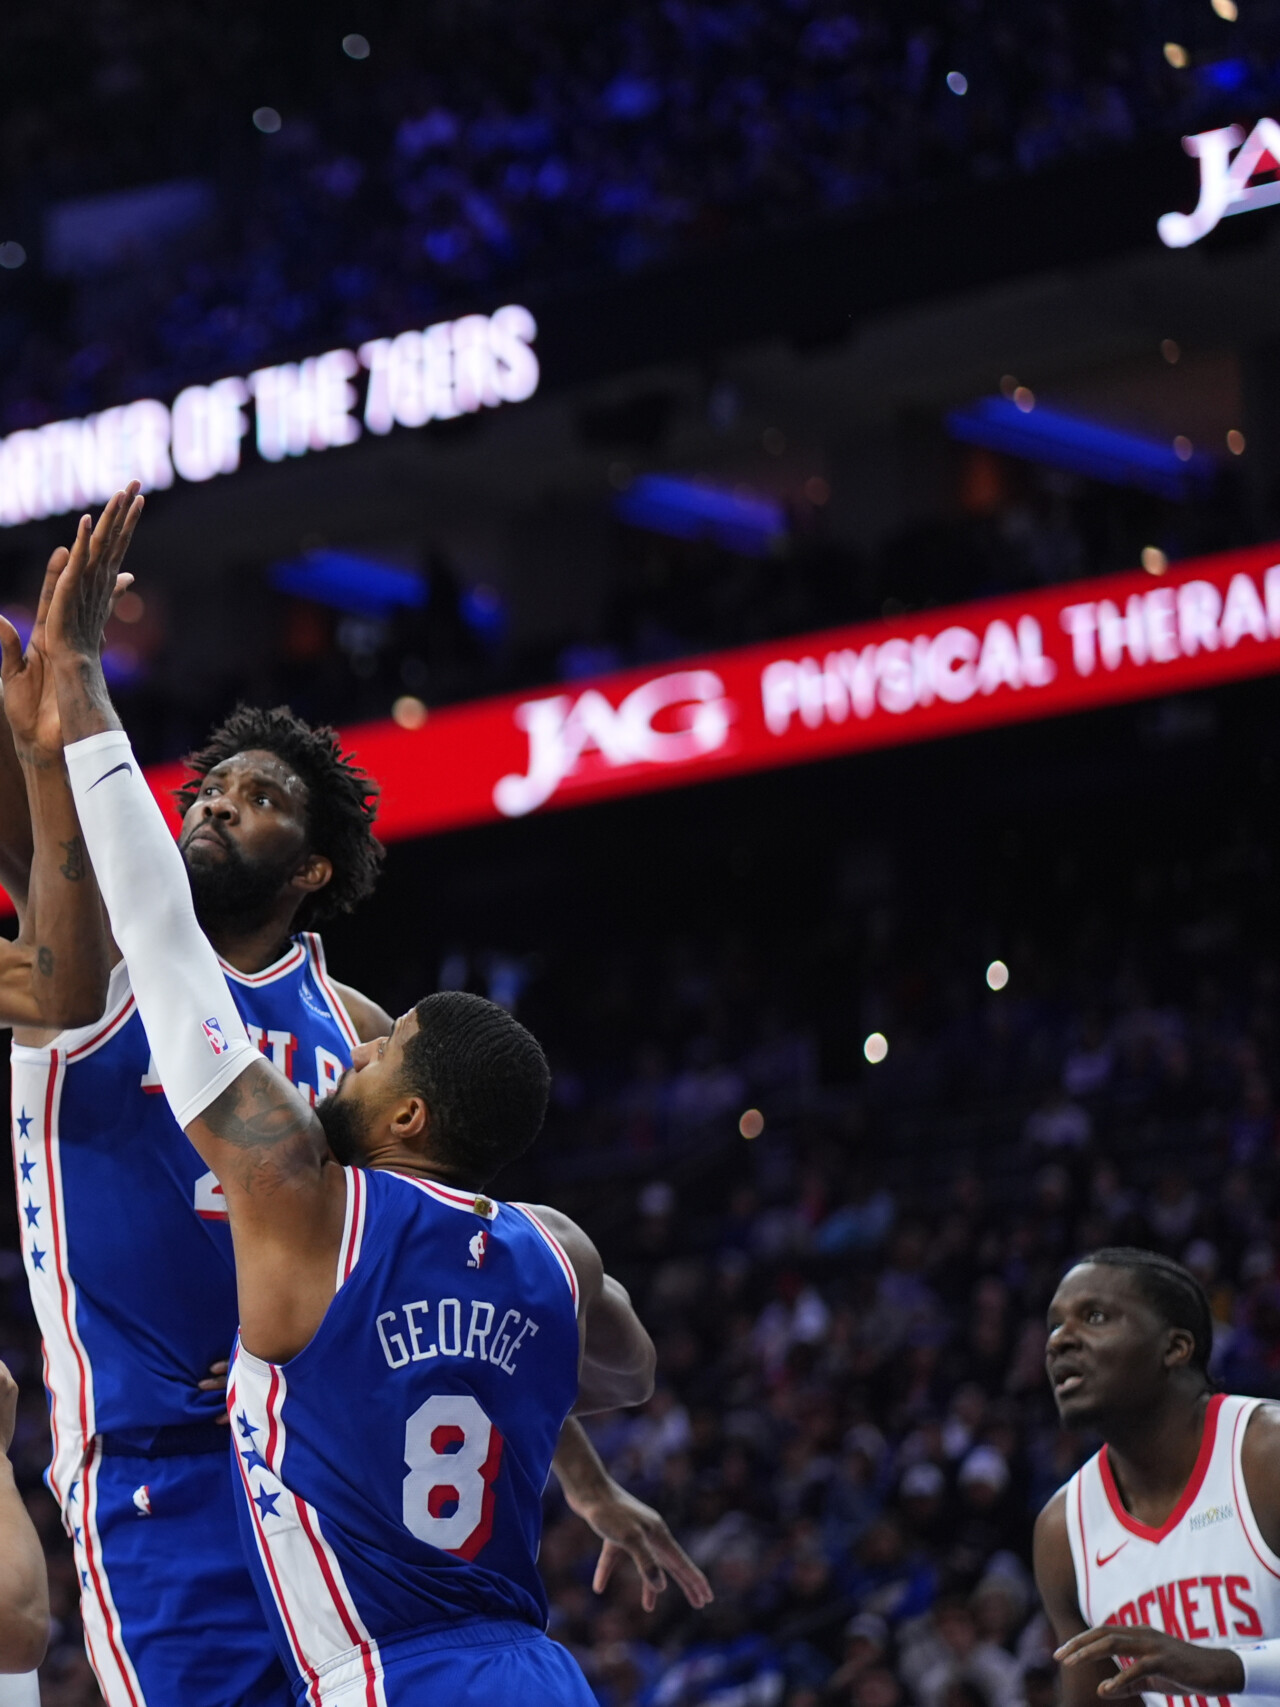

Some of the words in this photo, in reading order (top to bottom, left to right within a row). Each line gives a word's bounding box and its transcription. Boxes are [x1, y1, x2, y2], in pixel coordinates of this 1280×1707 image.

[172, 377, 248, 481] OF
[249, 348, 362, 462] THE
[358, 304, 540, 435] 76ERS
[493, 670, 732, 817] JAG
[761, 615, 1056, 735] PHYSICAL
[375, 1298, 539, 1376] GEORGE
[402, 1394, 504, 1562] 8
